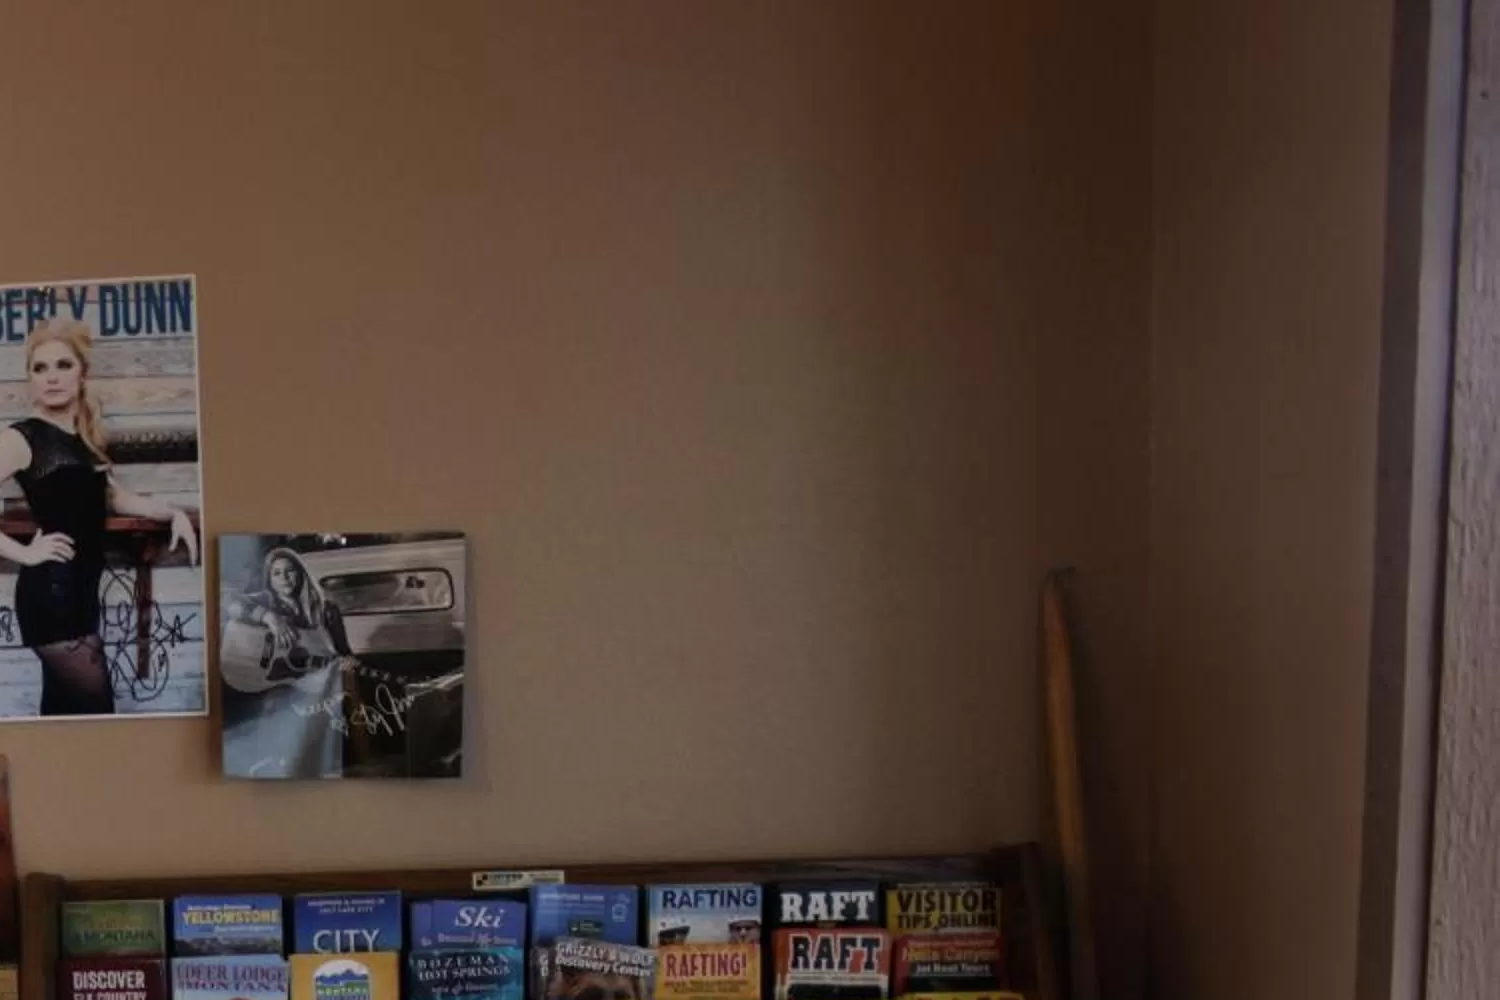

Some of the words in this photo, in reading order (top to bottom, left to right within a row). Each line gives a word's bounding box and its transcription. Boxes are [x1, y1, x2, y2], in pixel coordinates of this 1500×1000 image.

[99, 279, 192, 336] DUNN
[662, 889, 758, 909] RAFTING
[779, 890, 876, 922] RAFT
[897, 890, 998, 912] VISITOR
[182, 910, 282, 926] YELLOWSTONE
[455, 905, 506, 929] Ski
[313, 928, 381, 953] CITY
[556, 941, 607, 961] GRIZZLY
[417, 955, 510, 969] BOZEMAN
[791, 936, 881, 970] RAFT
[452, 964, 511, 979] SPRINGS
[555, 955, 611, 974] Discovery
[613, 960, 654, 978] Center
[665, 951, 747, 978] RAFTING!
[72, 970, 146, 991] DISCOVER
